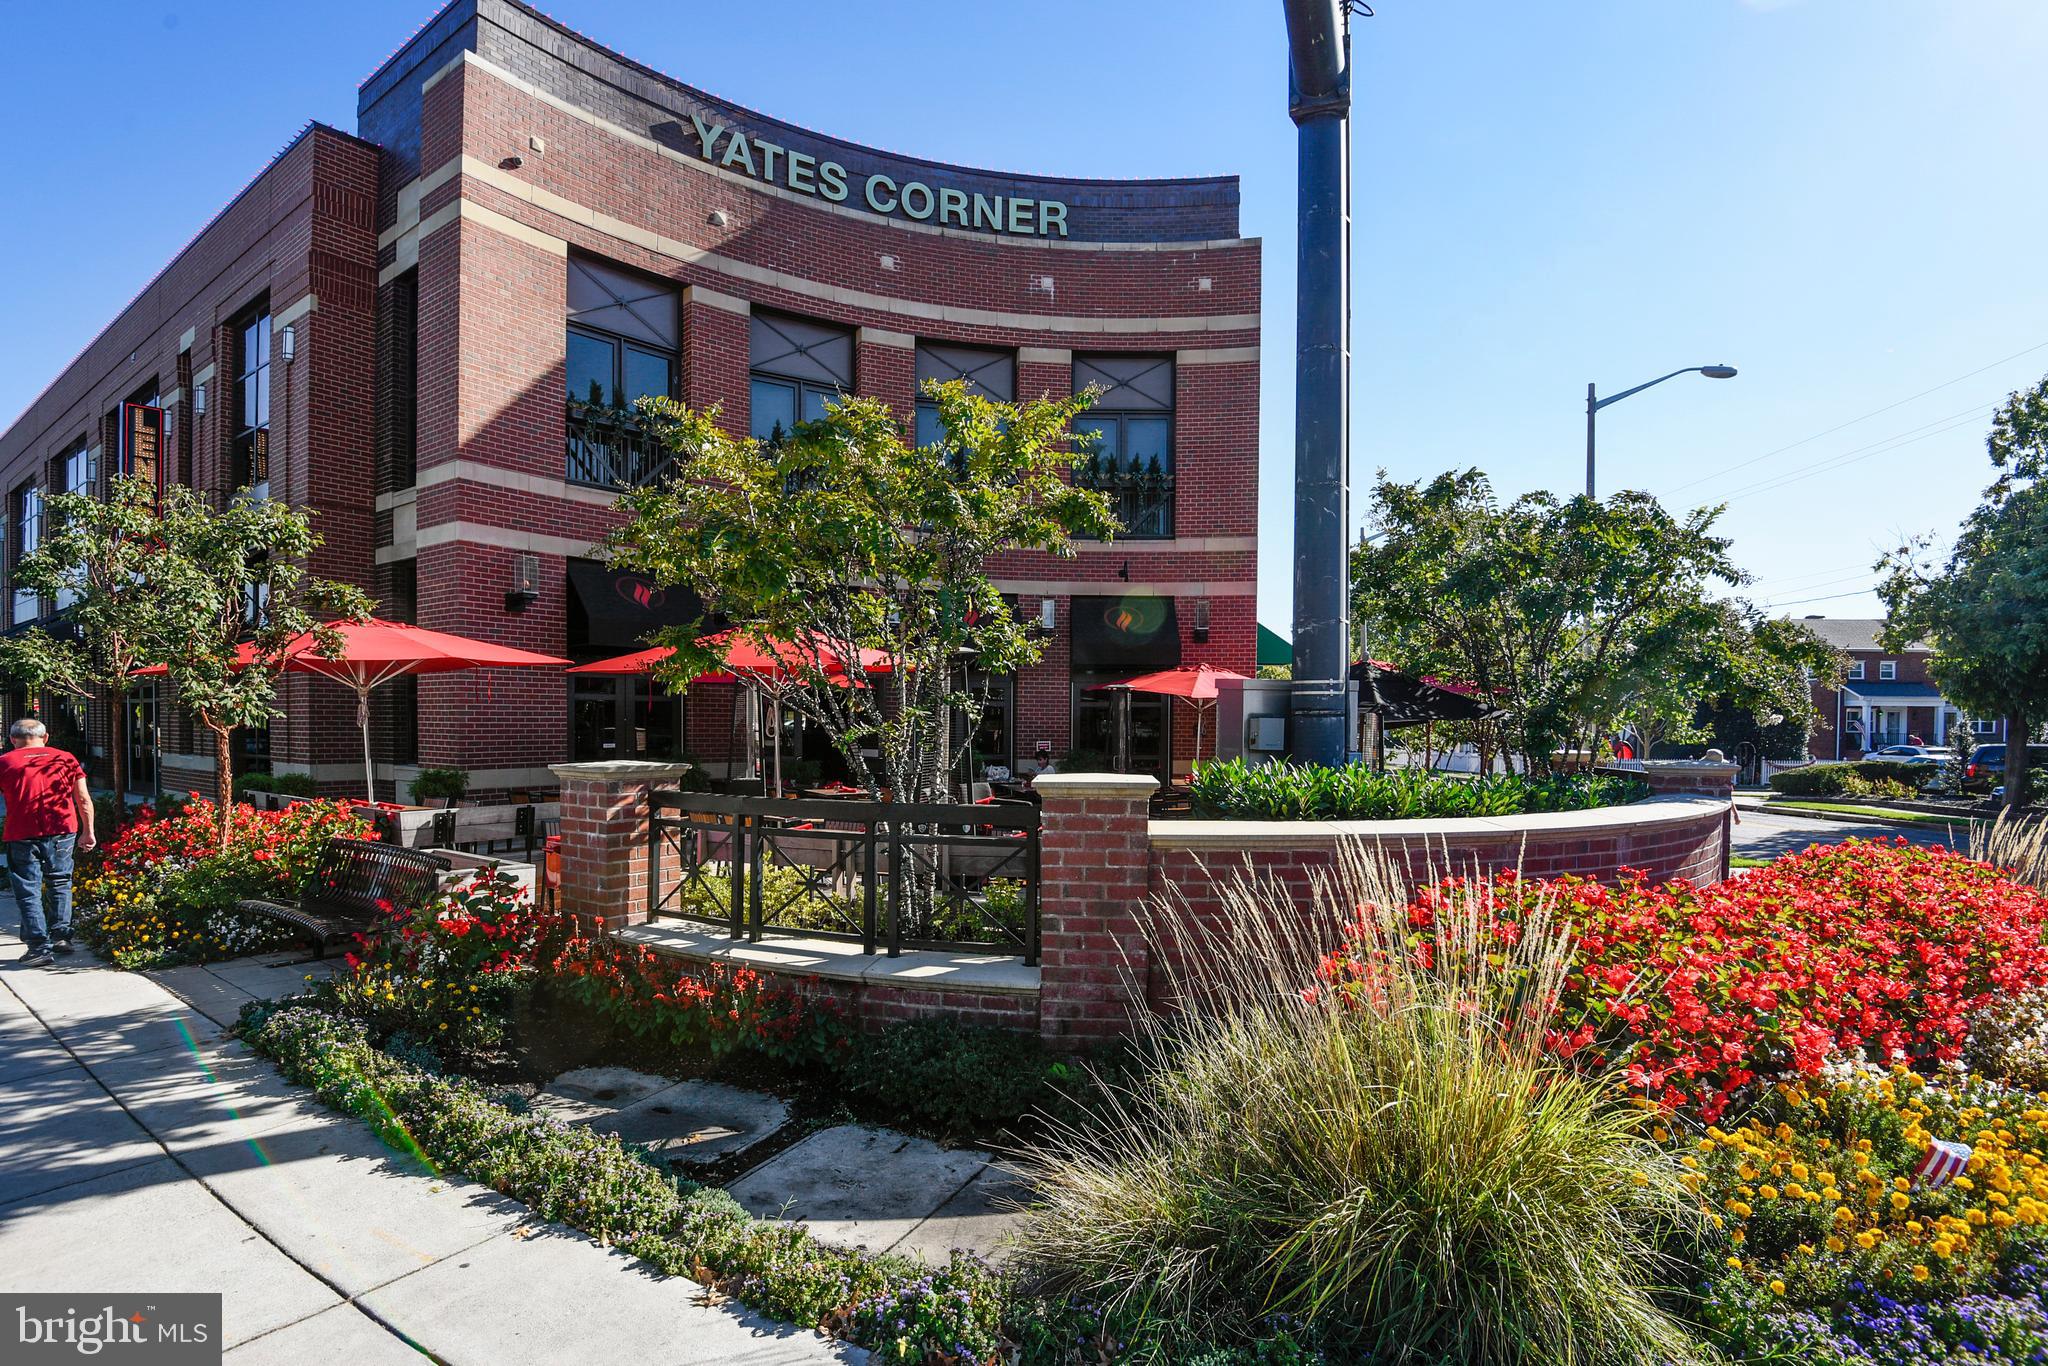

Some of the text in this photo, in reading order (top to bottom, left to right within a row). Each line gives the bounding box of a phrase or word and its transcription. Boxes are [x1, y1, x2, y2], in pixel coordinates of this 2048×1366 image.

[691, 115, 1068, 236] YATES CORNER
[134, 407, 157, 518] LEN
